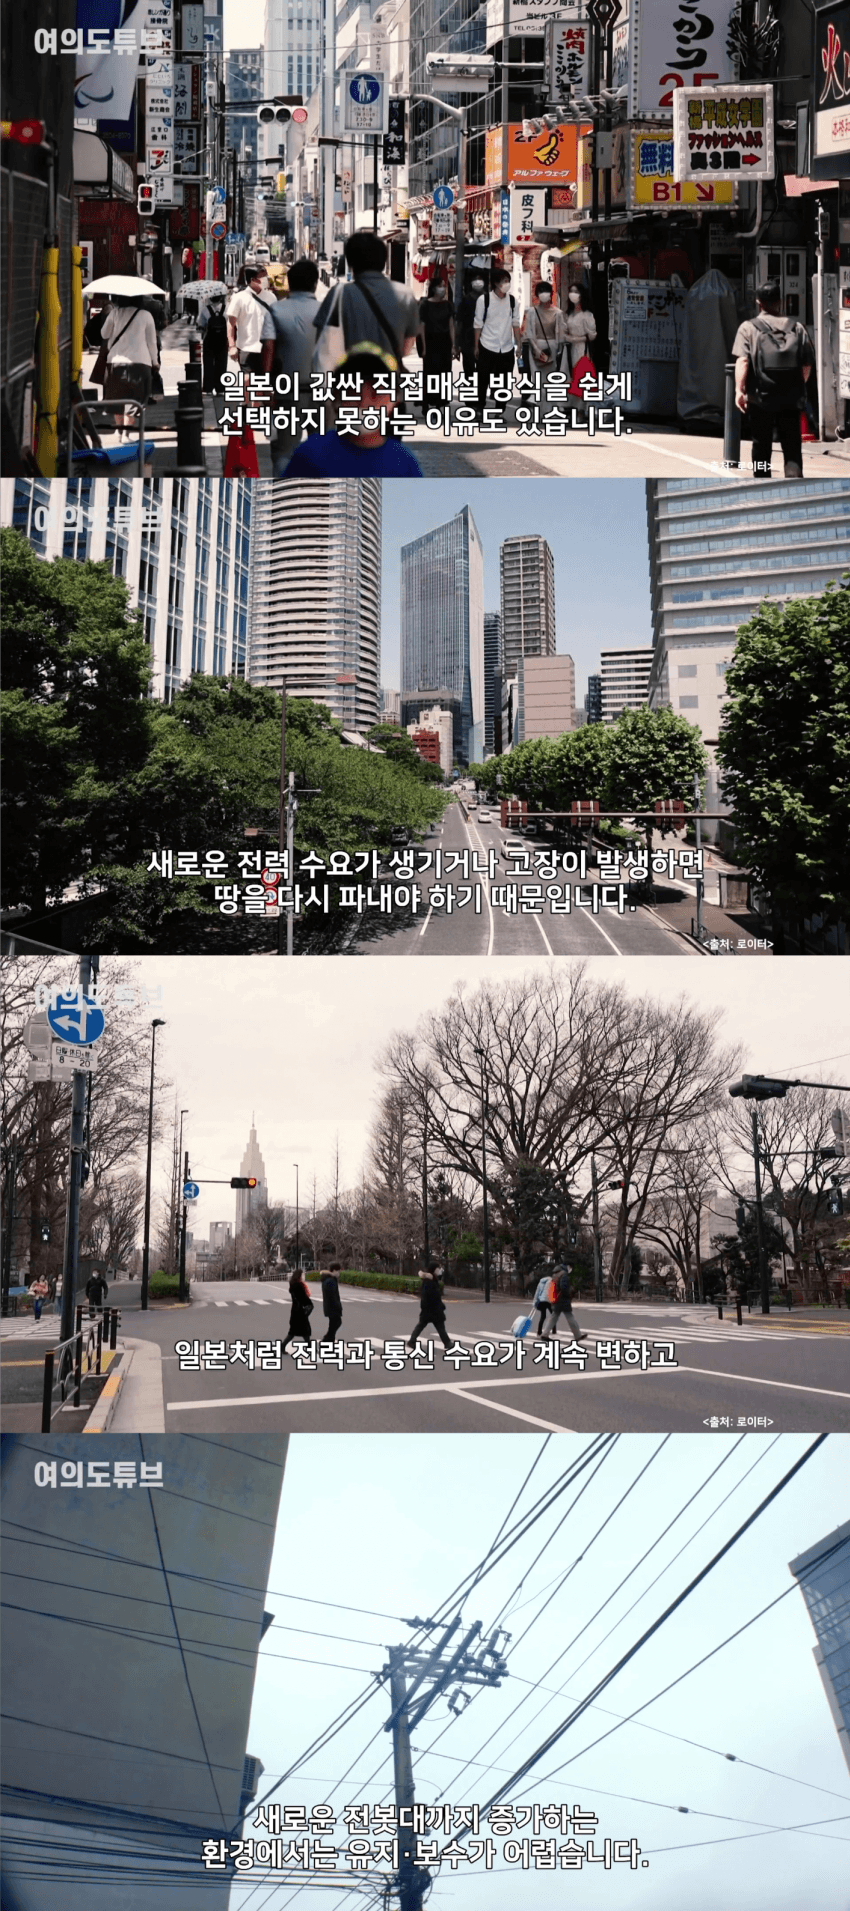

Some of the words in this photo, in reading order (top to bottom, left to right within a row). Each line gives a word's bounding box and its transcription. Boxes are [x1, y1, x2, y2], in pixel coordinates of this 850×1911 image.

[652, 182, 682, 202] B1
[521, 194, 535, 233] 皮フ科
[79, 1059, 91, 1068] 20
